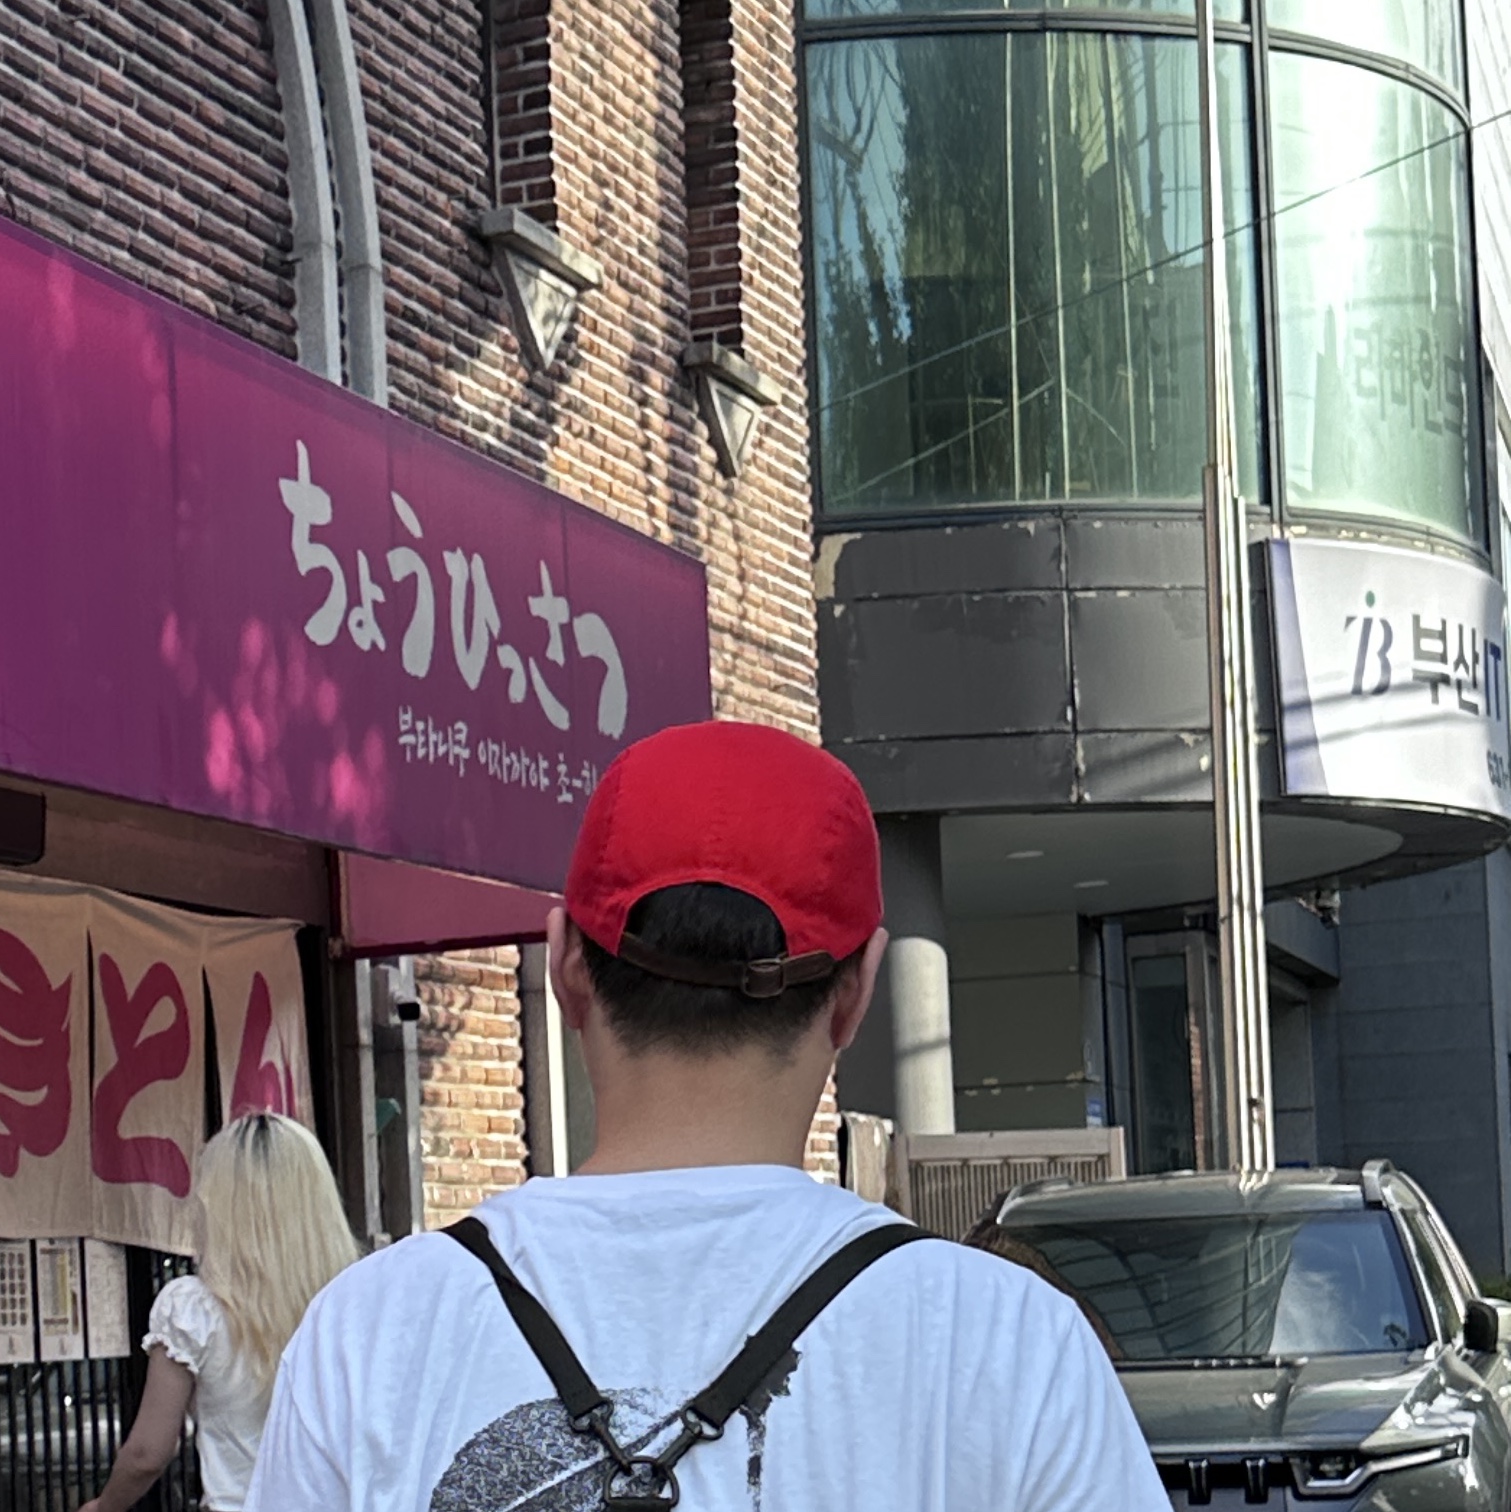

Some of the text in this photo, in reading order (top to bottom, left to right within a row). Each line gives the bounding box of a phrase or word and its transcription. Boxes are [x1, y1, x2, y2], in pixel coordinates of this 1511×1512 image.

[279, 440, 628, 740] ちょうひっさつ
[398, 705, 471, 778] 부타니쿠
[477, 737, 550, 792] 이자까야
